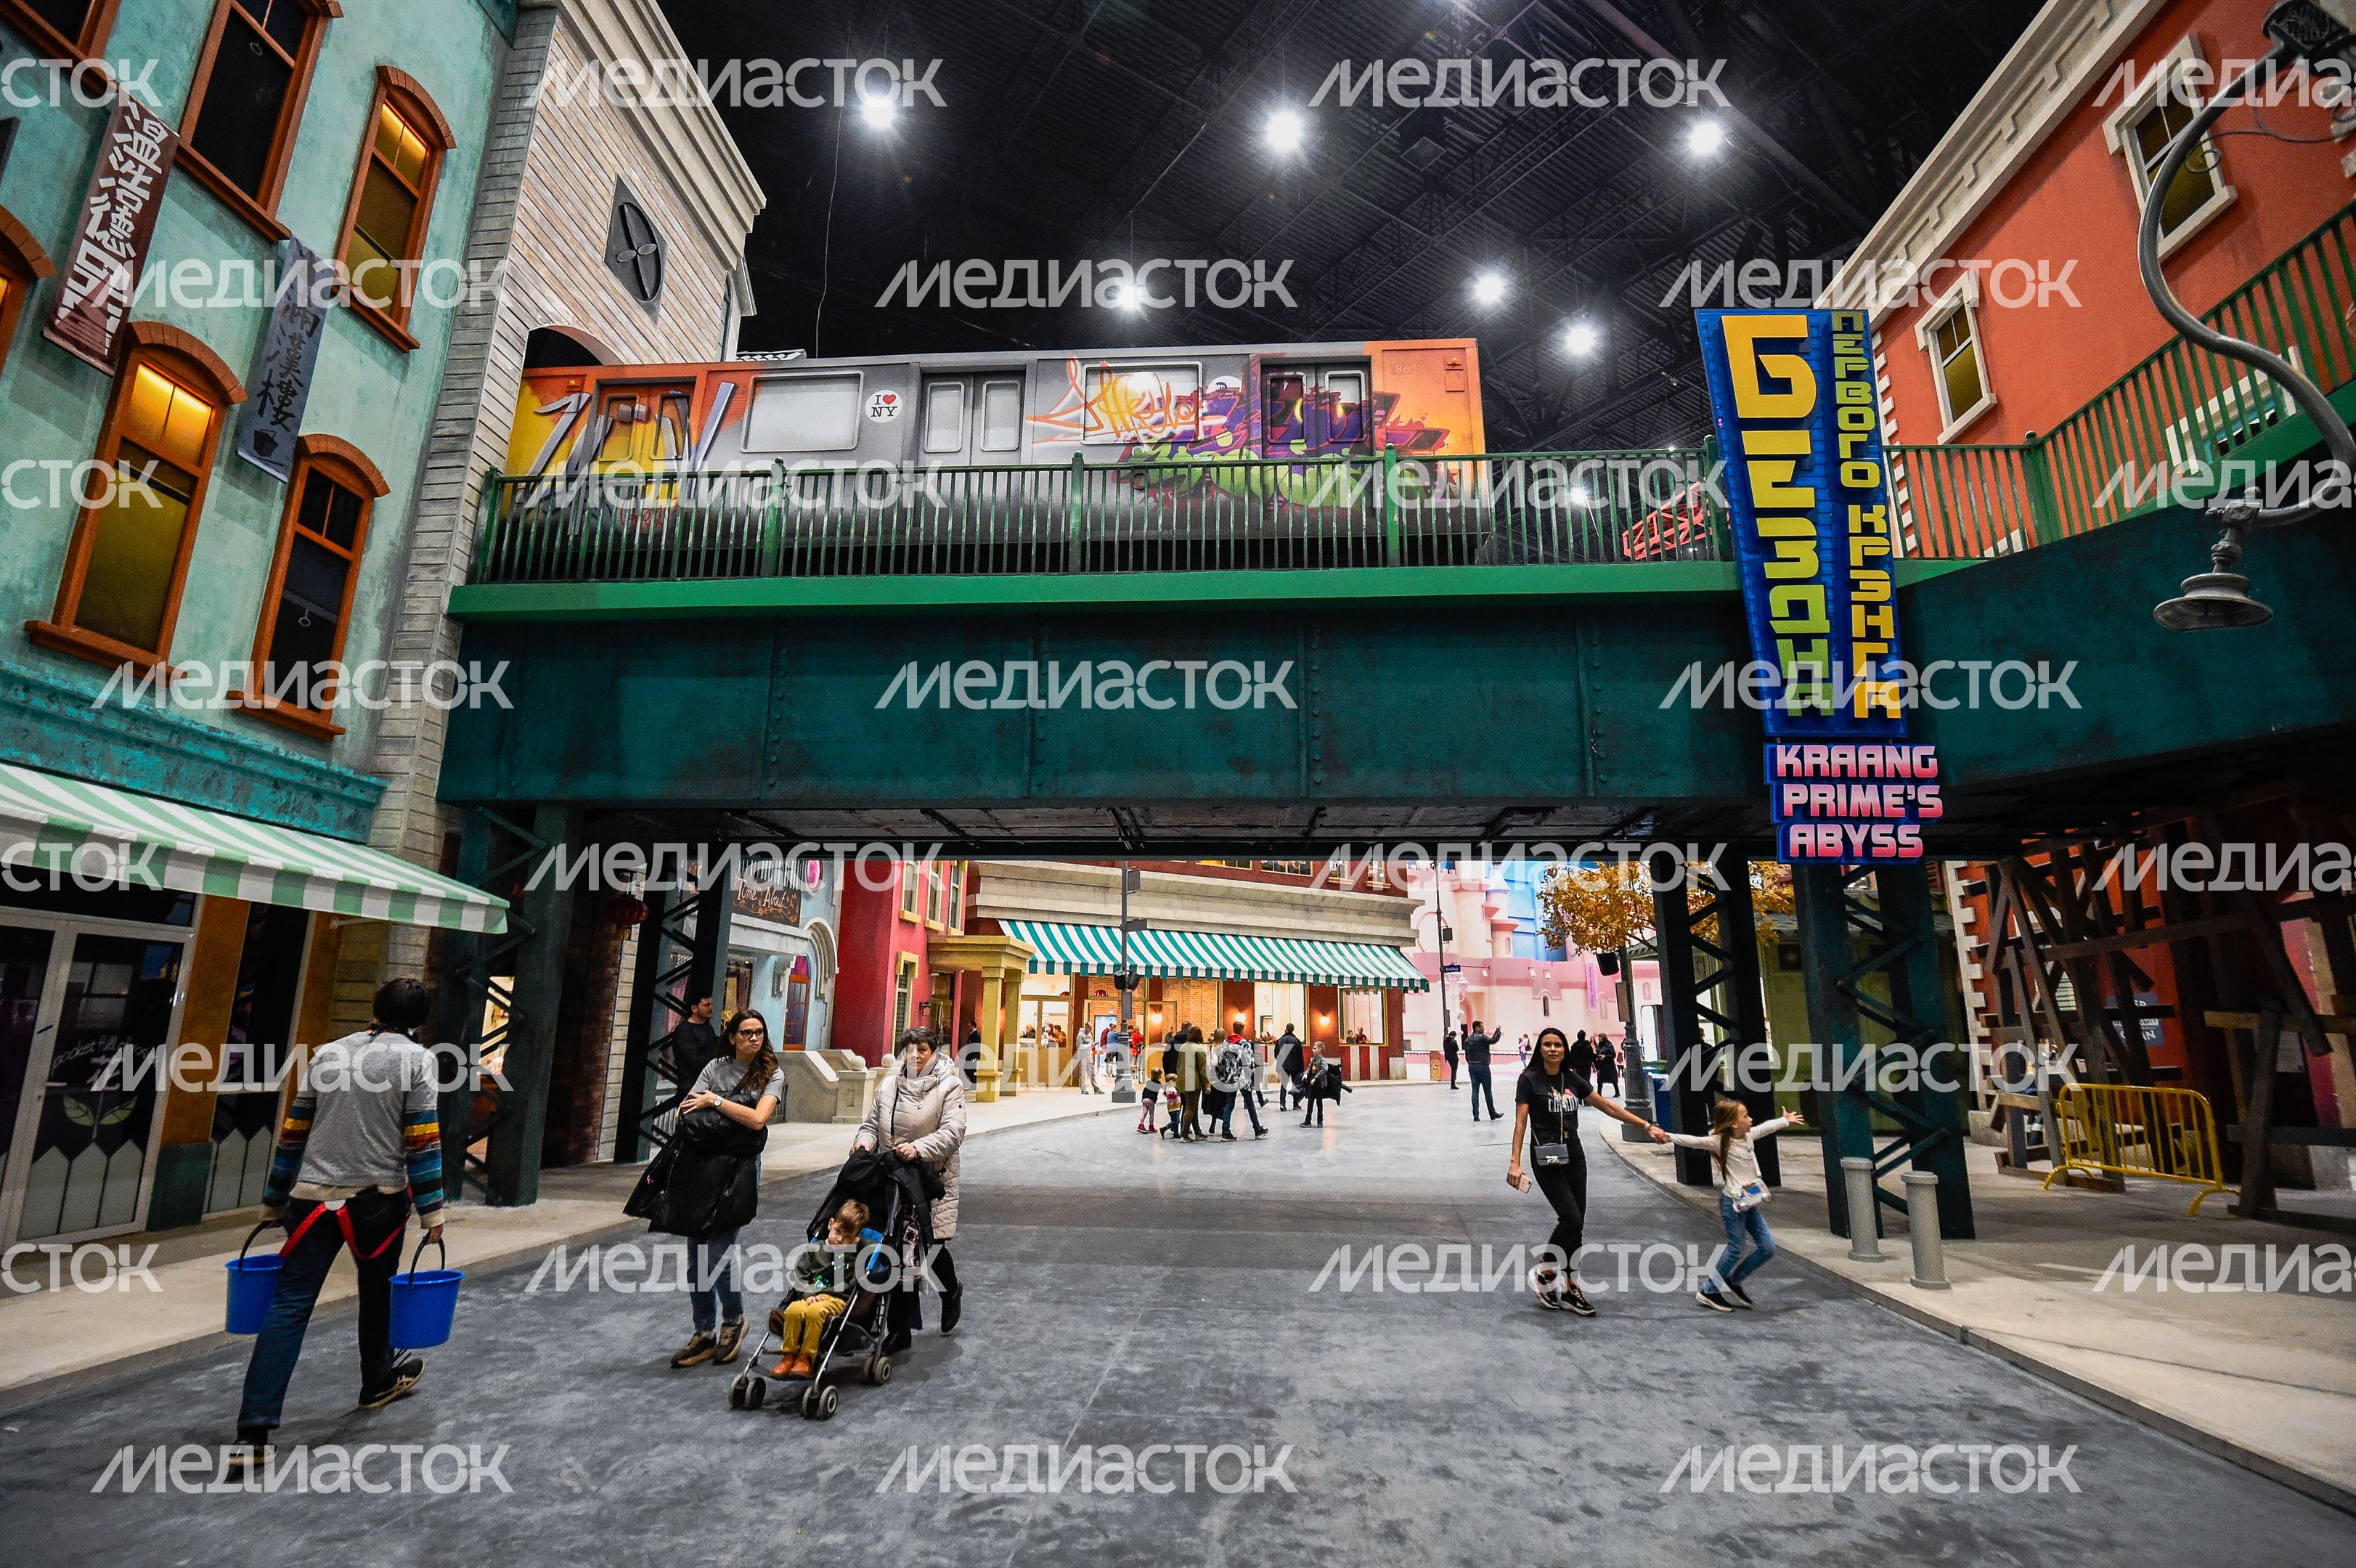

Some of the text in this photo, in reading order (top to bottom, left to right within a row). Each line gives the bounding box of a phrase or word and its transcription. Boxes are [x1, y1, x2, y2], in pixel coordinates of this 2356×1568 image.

[871, 407, 898, 417] NY
[874, 394, 881, 405] I
[1720, 314, 1835, 717] БЕЗДНА
[1830, 310, 1902, 720] ПЕРВОГО КРЭНГА
[1776, 744, 1939, 779] KRAANG
[1783, 784, 1944, 819] PRIME'S
[1789, 823, 1925, 859] ABYSS
[736, 878, 758, 901] Time
